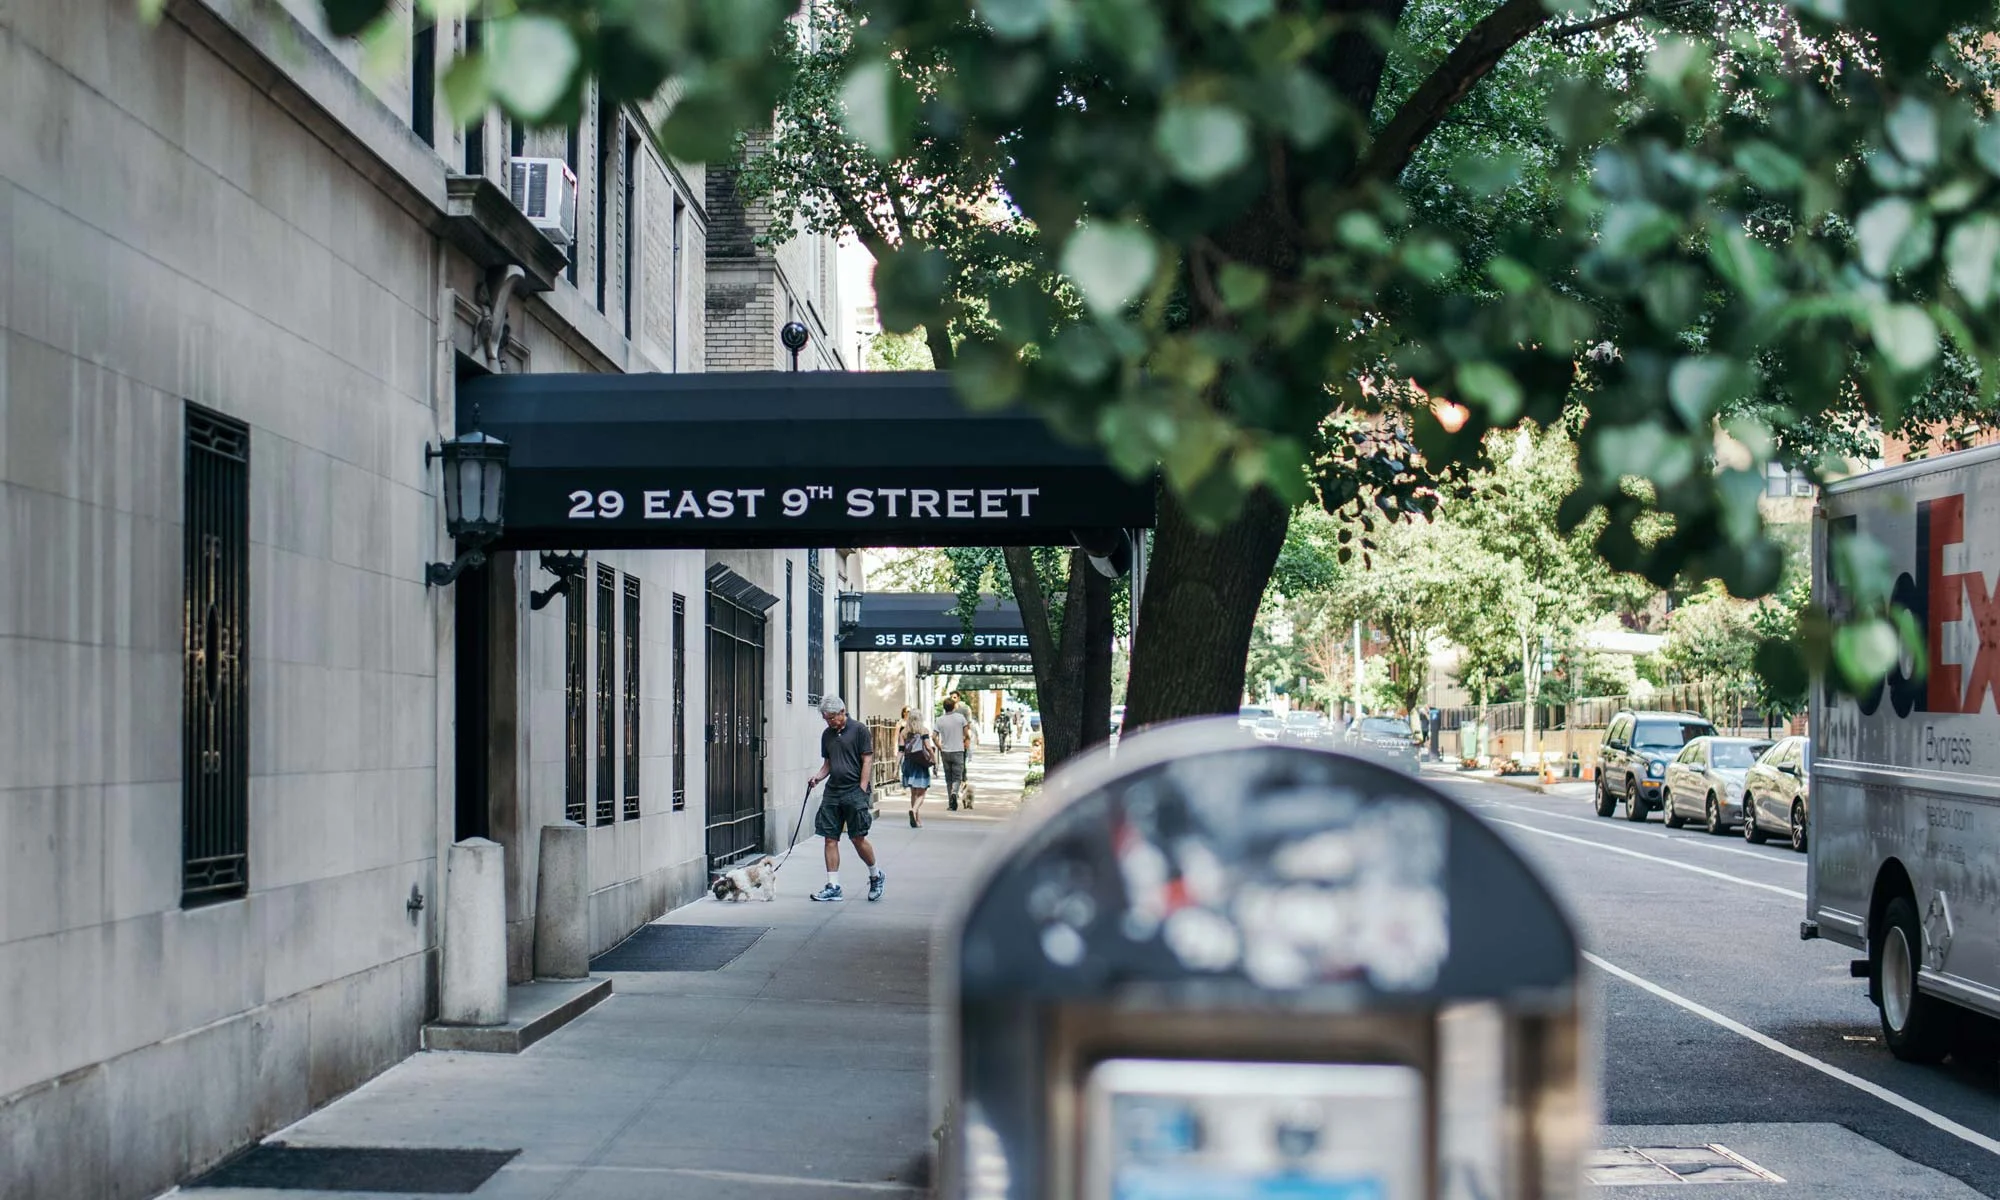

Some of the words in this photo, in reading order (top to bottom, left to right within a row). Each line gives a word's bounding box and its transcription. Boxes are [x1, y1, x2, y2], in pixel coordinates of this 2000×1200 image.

[568, 490, 624, 519] 29
[643, 488, 766, 519] EAST
[782, 485, 833, 517] 9TH
[846, 487, 1039, 518] STREET
[1824, 493, 2000, 719] dEx
[875, 634, 897, 646] 35
[902, 634, 946, 646] EAST
[951, 633, 968, 646] 9T
[974, 634, 1029, 647] STREE
[938, 664, 953, 673] 45
[955, 664, 983, 673] EAST
[998, 664, 1033, 674] STREE
[1926, 726, 1972, 770] Express
